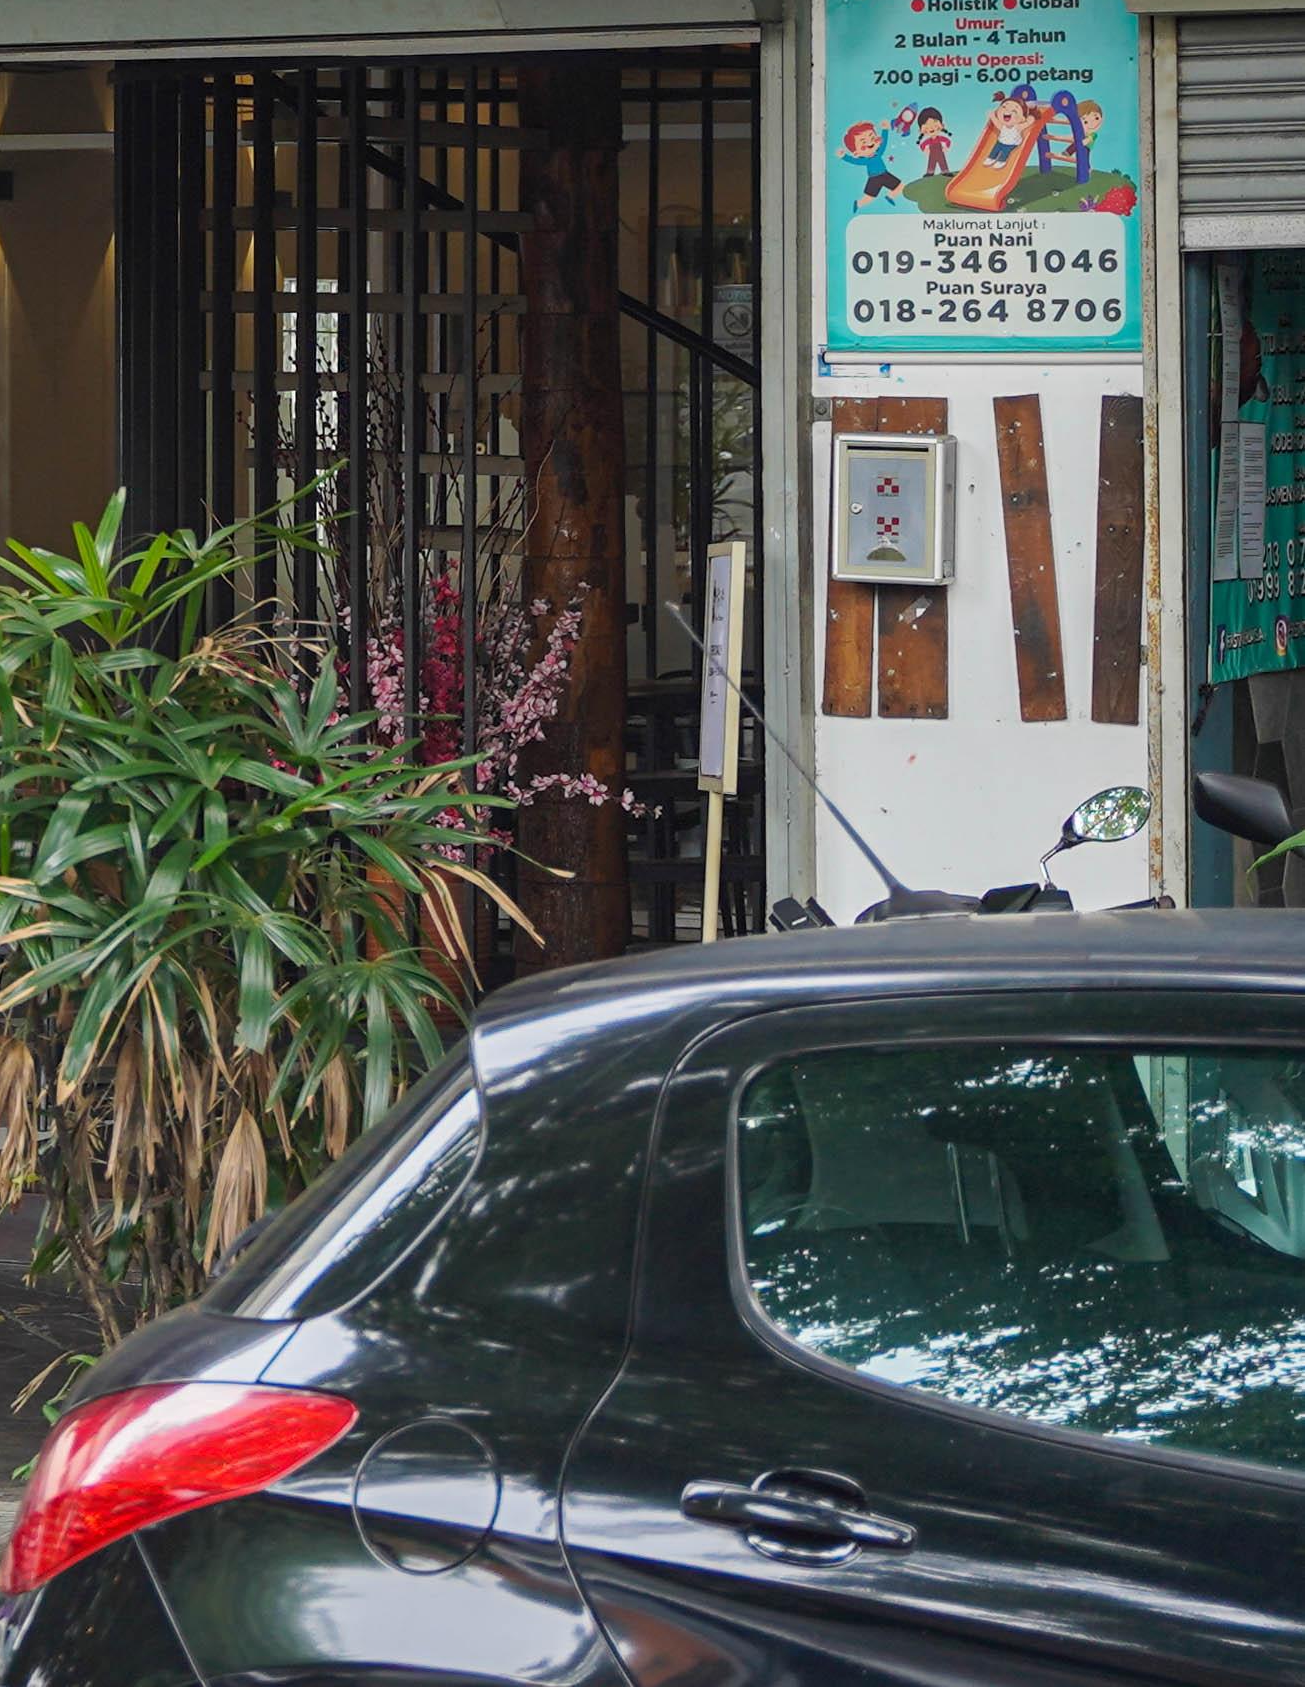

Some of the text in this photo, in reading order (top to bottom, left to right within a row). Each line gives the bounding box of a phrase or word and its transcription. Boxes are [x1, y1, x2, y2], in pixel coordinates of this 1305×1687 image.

[955, 17, 1005, 30] Umur:
[894, 34, 907, 49] 2
[912, 32, 968, 48] Bulan
[986, 30, 1000, 46] 4
[1008, 29, 1067, 45] Tahun
[920, 52, 1044, 69] Waktu Operasi:
[873, 69, 914, 85] 7.00
[918, 67, 959, 87] pagi
[976, 68, 1021, 83] 6.00
[1026, 67, 1094, 86] petang
[922, 218, 993, 231] Maklumat
[996, 218, 1039, 232] Lanjut
[933, 232, 1033, 248] Puan Nani
[851, 248, 1119, 275] 019-346 1046
[925, 281, 1047, 298] Puan Suraya
[853, 298, 1122, 323] 018-264 8706
